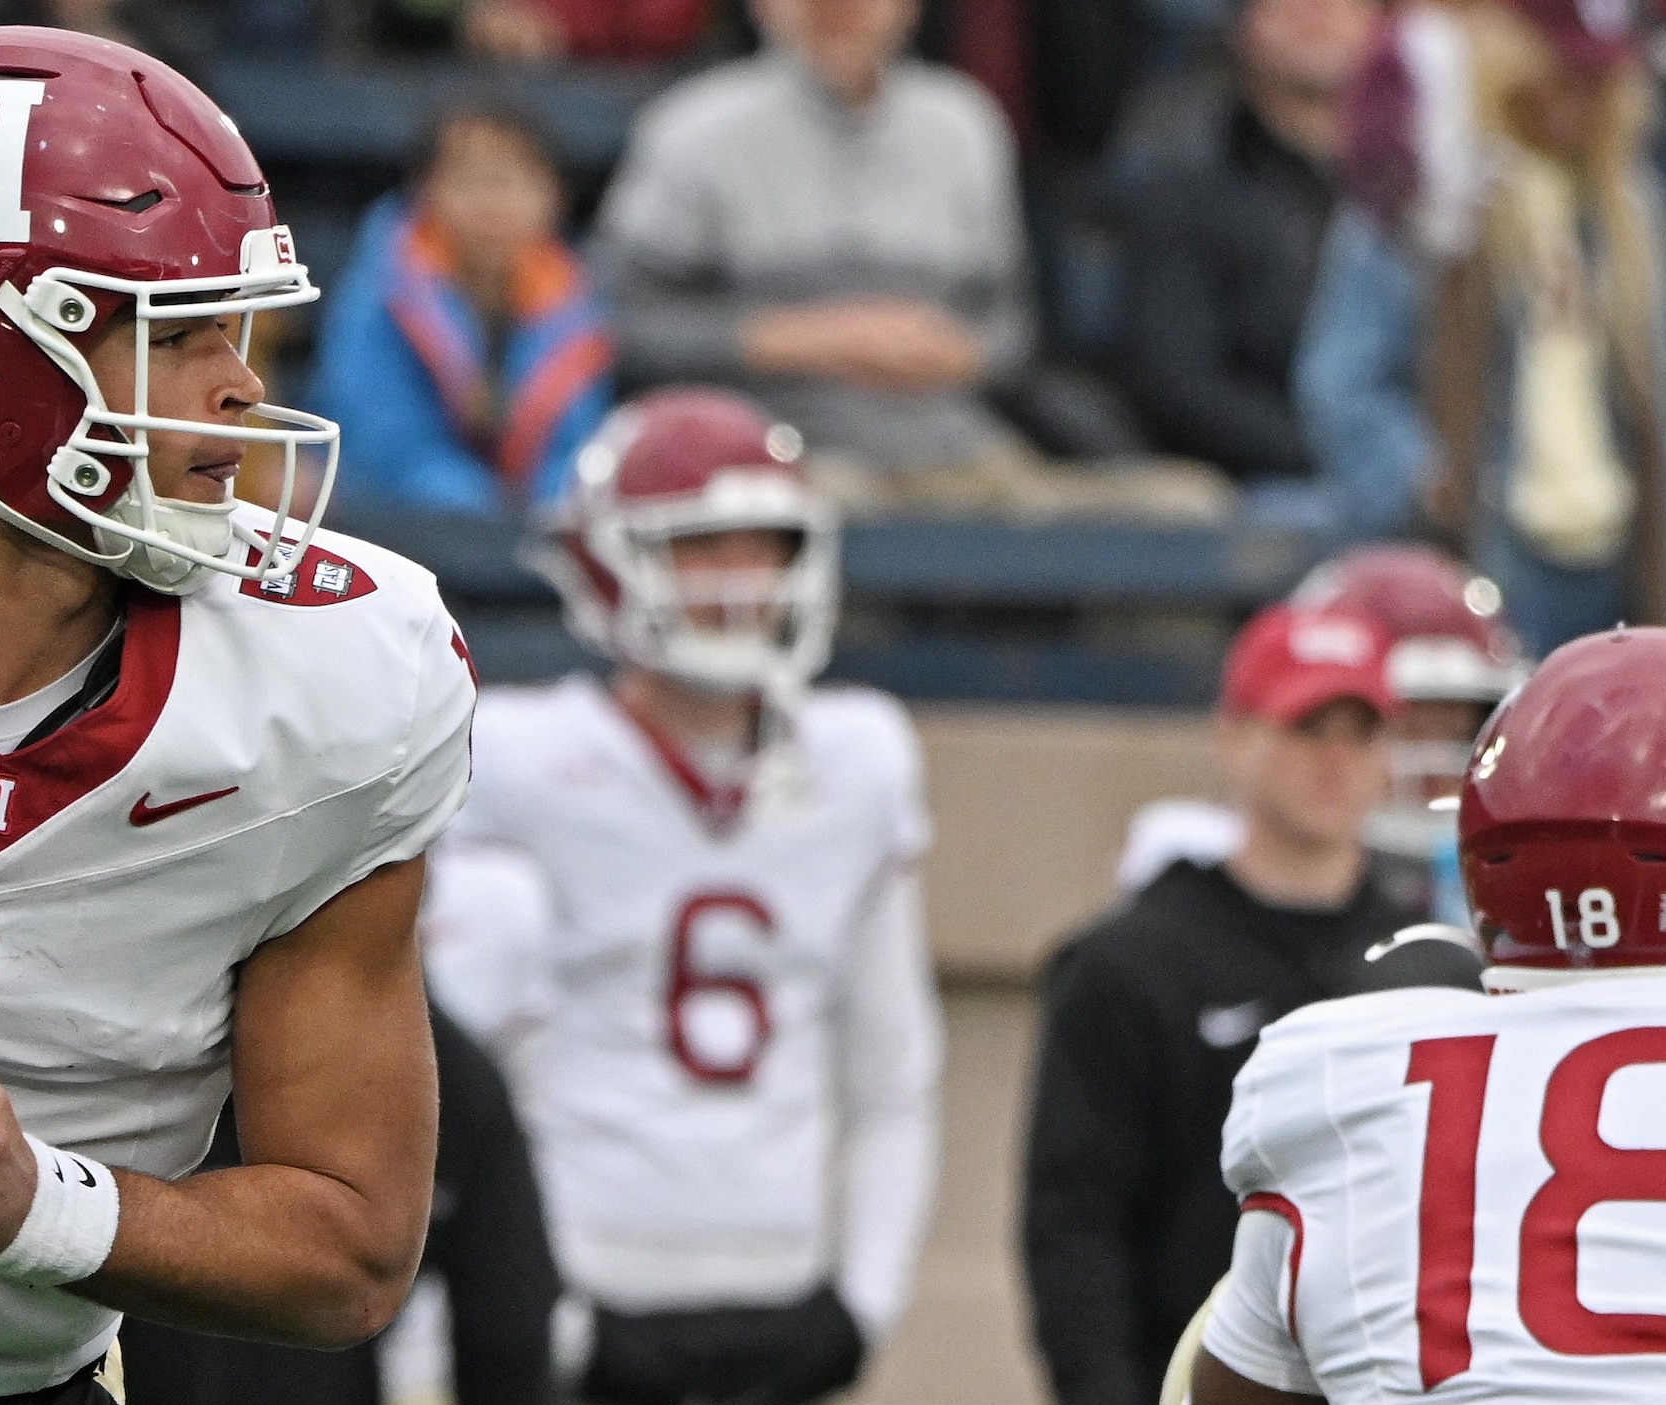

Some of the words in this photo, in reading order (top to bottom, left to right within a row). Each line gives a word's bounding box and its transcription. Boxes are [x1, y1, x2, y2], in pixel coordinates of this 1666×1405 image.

[320, 566, 341, 588] TAS
[1545, 887, 1621, 950] 18
[666, 888, 775, 1090] 6
